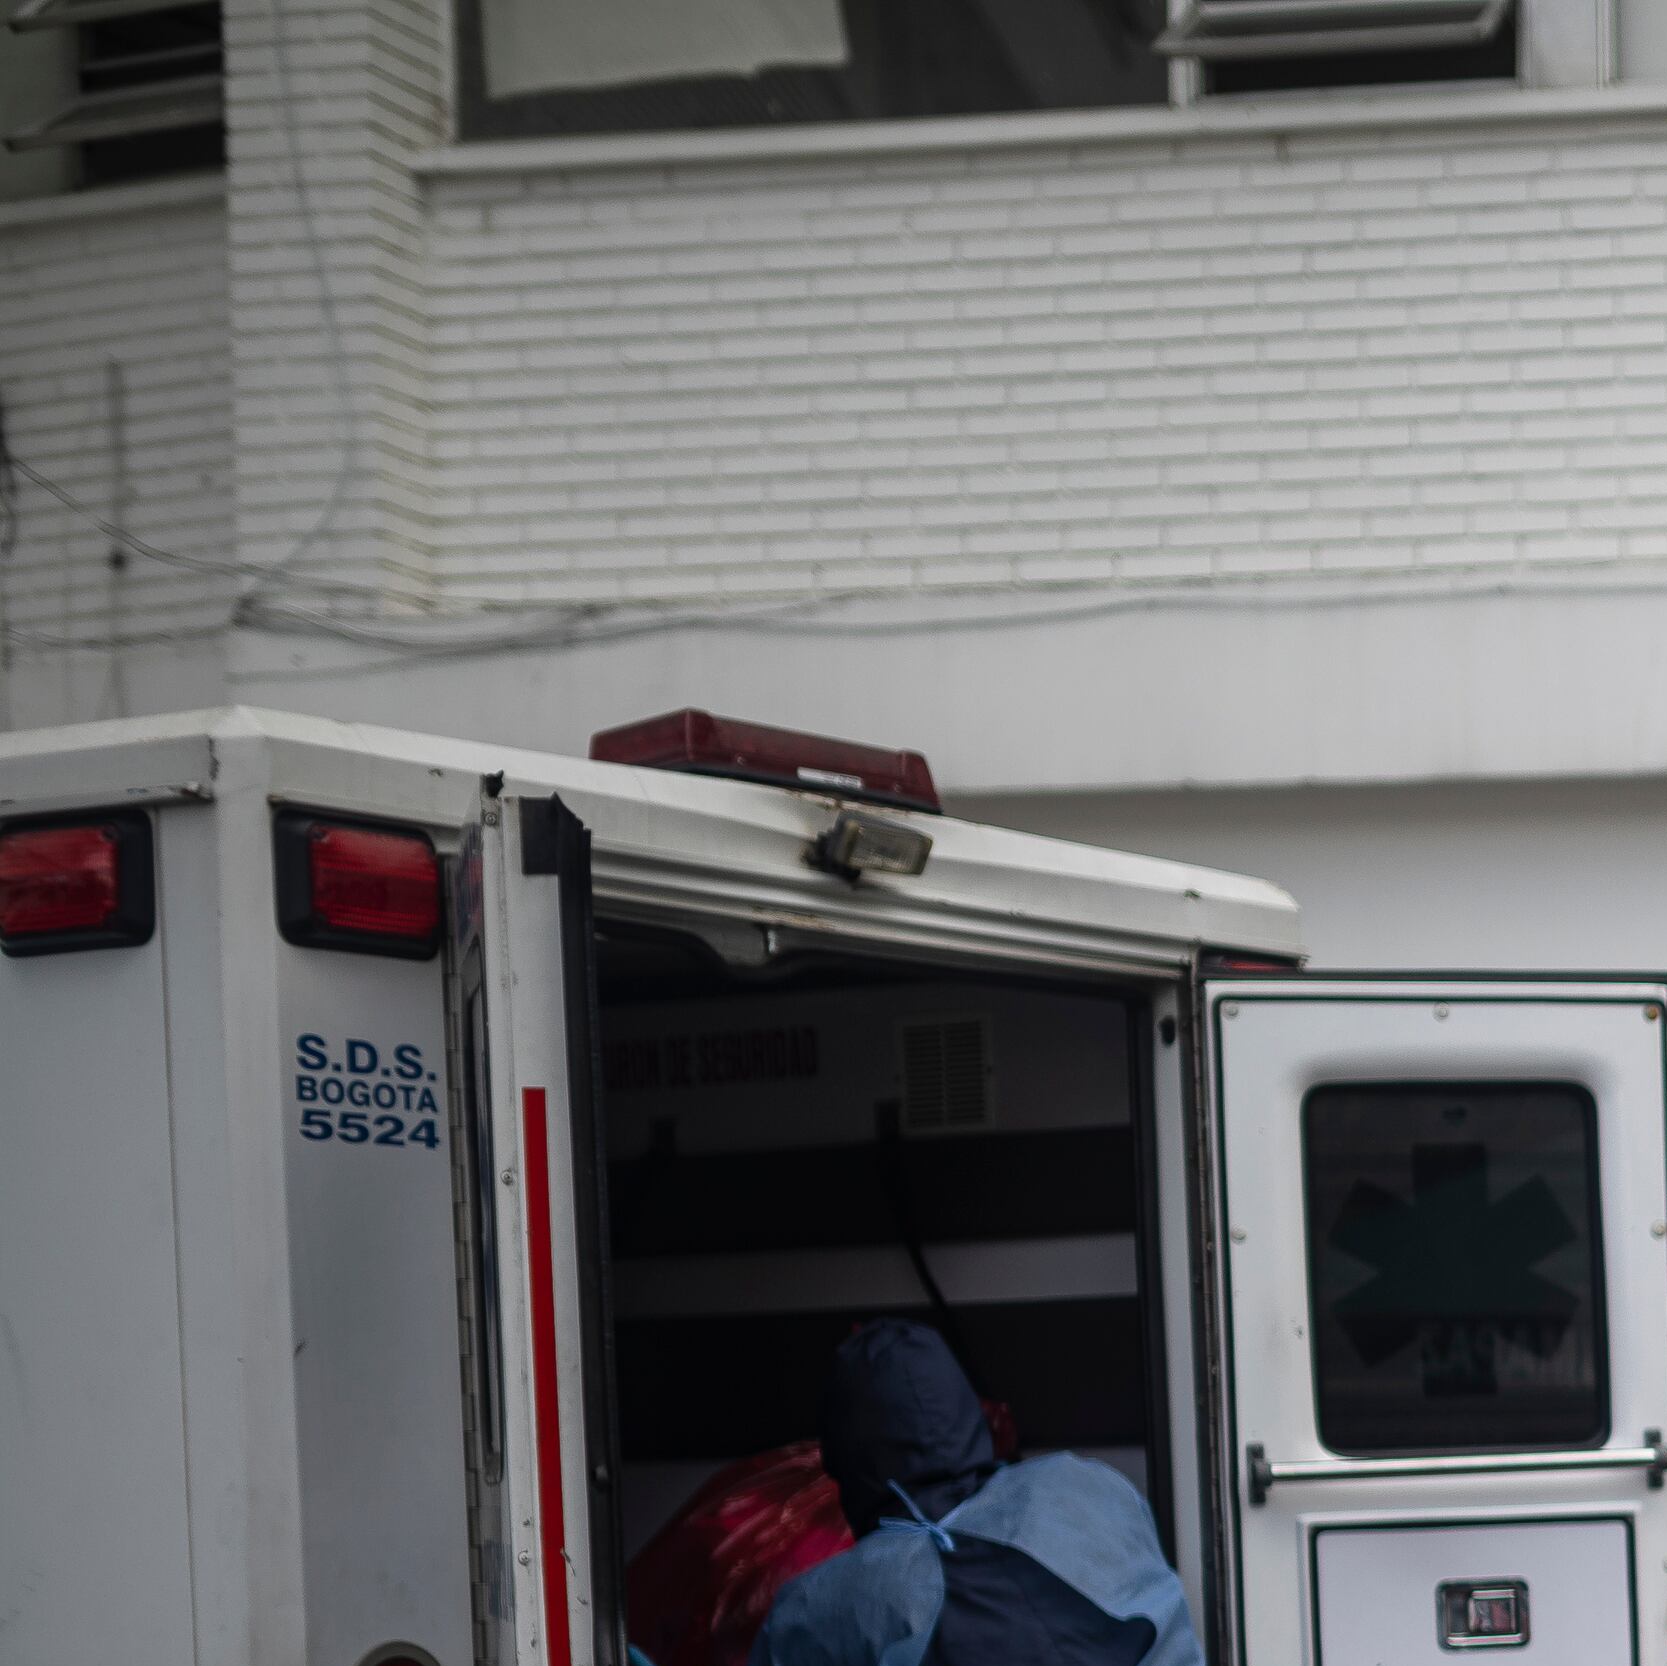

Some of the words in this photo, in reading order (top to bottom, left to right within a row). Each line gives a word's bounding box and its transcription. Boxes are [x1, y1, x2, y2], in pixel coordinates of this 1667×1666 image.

[296, 1033, 437, 1081] S.D.S.
[667, 1035, 692, 1087] DE
[697, 1026, 819, 1086] SEGURIDAD
[295, 1074, 439, 1113] BOGOTA
[299, 1108, 440, 1149] 5524
